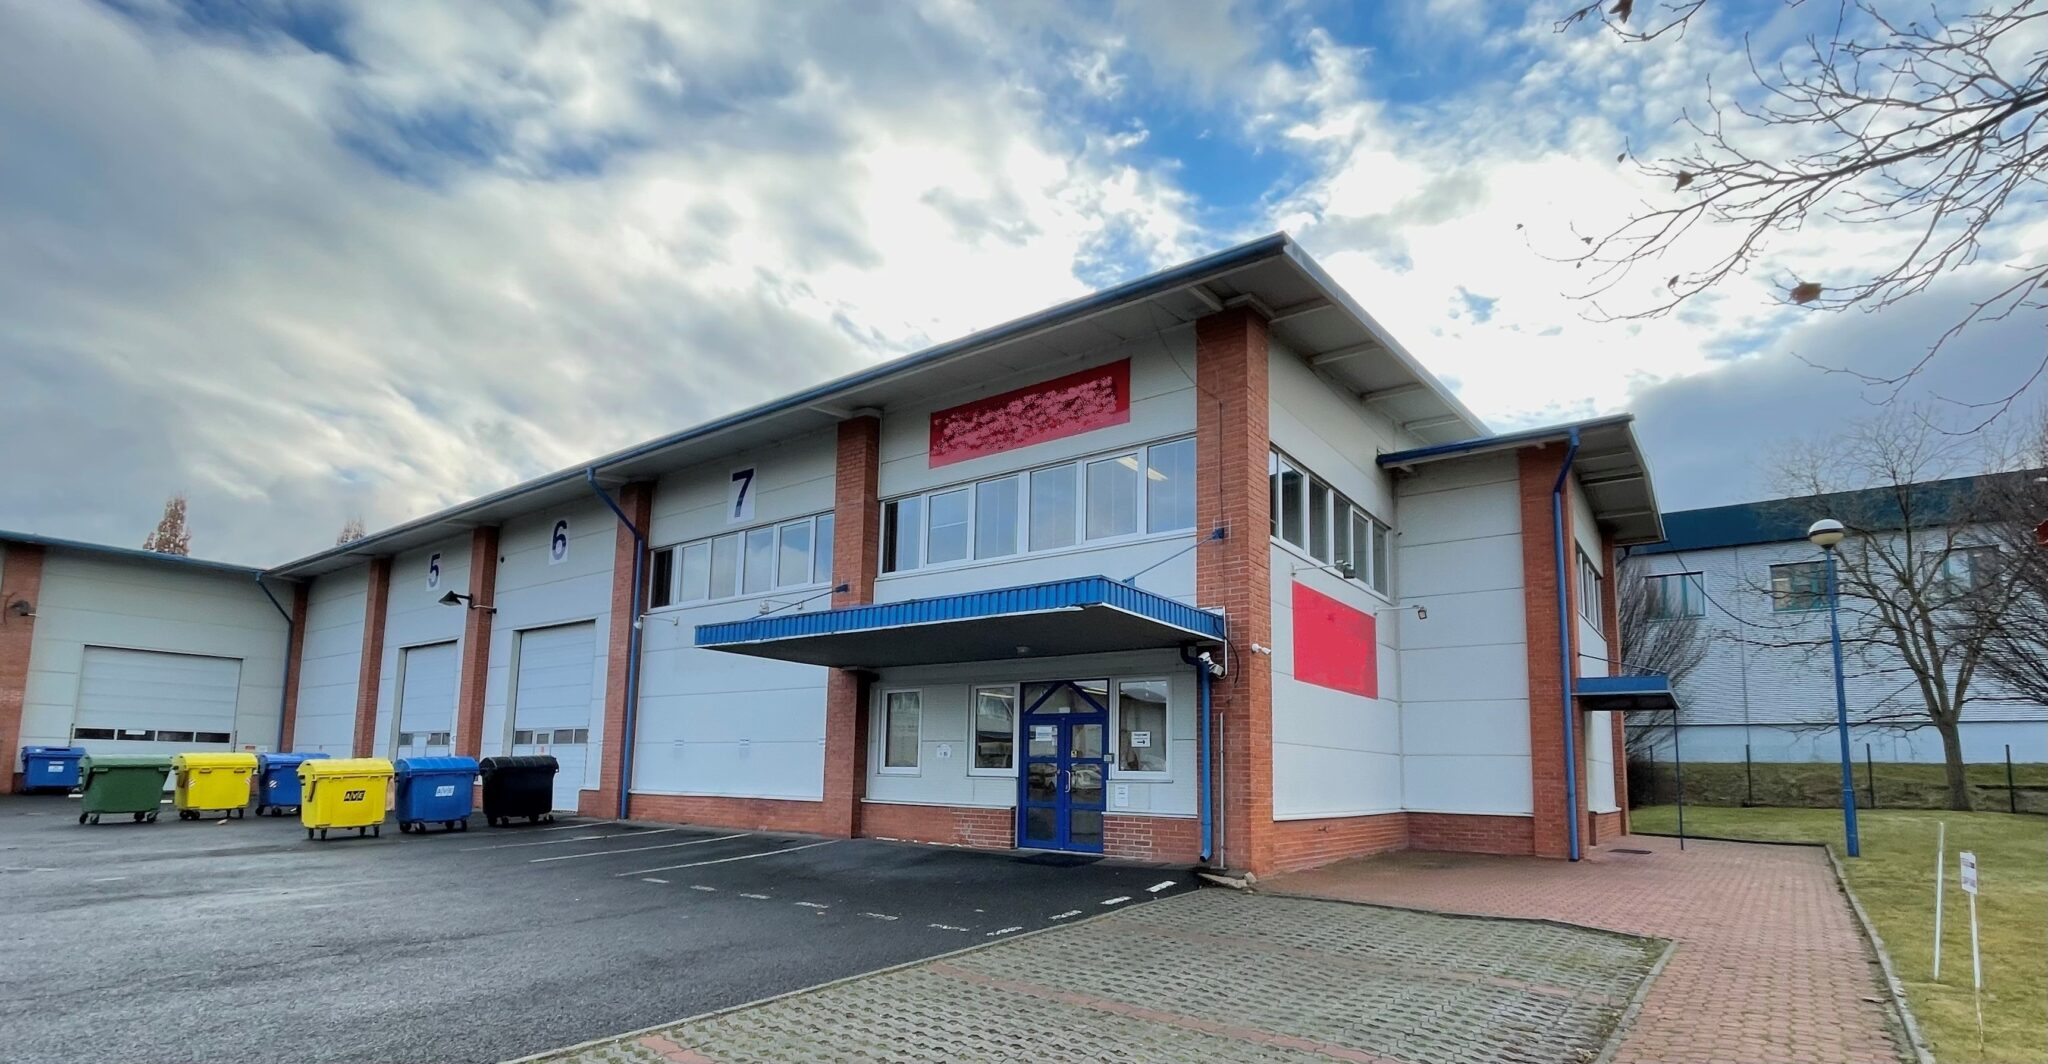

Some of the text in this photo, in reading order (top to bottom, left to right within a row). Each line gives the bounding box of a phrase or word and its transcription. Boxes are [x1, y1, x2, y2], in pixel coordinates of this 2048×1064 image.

[732, 468, 754, 517] 7
[552, 520, 567, 560] 6
[428, 553, 440, 587] 5
[345, 791, 364, 800] AVE
